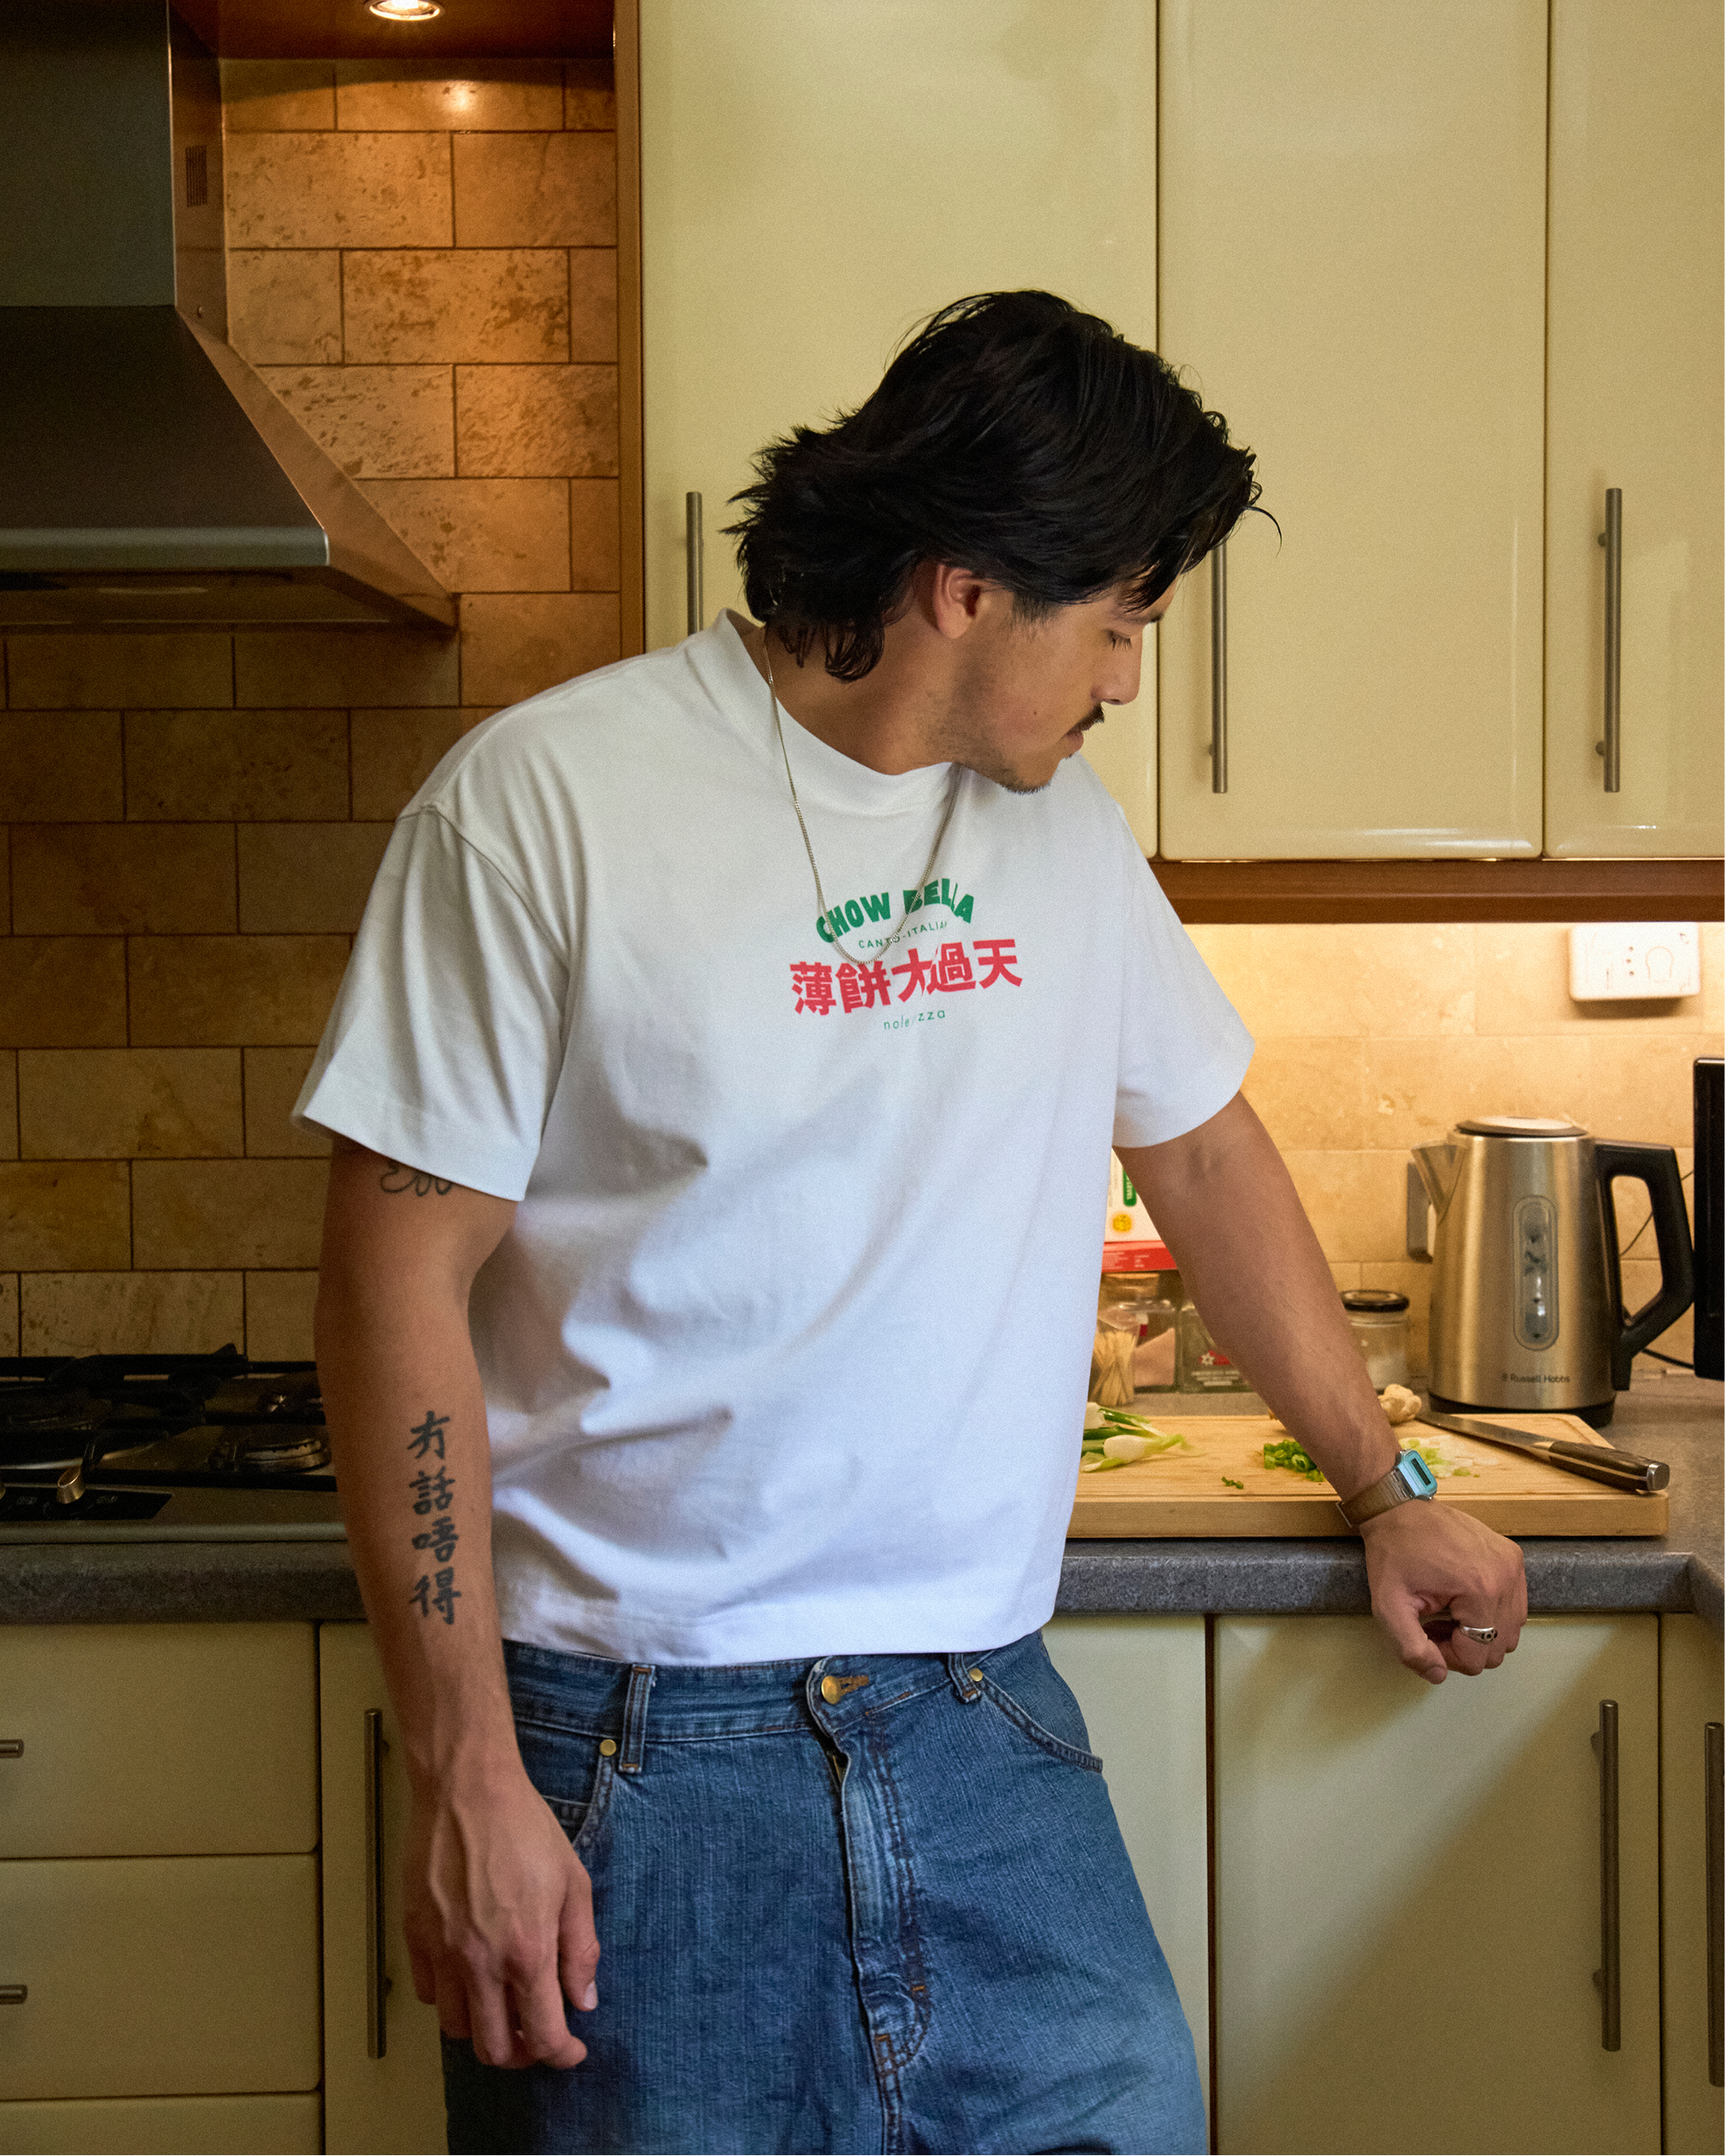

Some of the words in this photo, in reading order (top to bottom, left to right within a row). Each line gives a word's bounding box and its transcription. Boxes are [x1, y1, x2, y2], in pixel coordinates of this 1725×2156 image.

[816, 892, 891, 943] CHOW
[790, 938, 1023, 1016] 薄餅大過天
[1510, 1374, 1541, 1384] Russell
[1543, 1375, 1570, 1384] Hobbs
[408, 1411, 462, 1625] 冇話唔得
